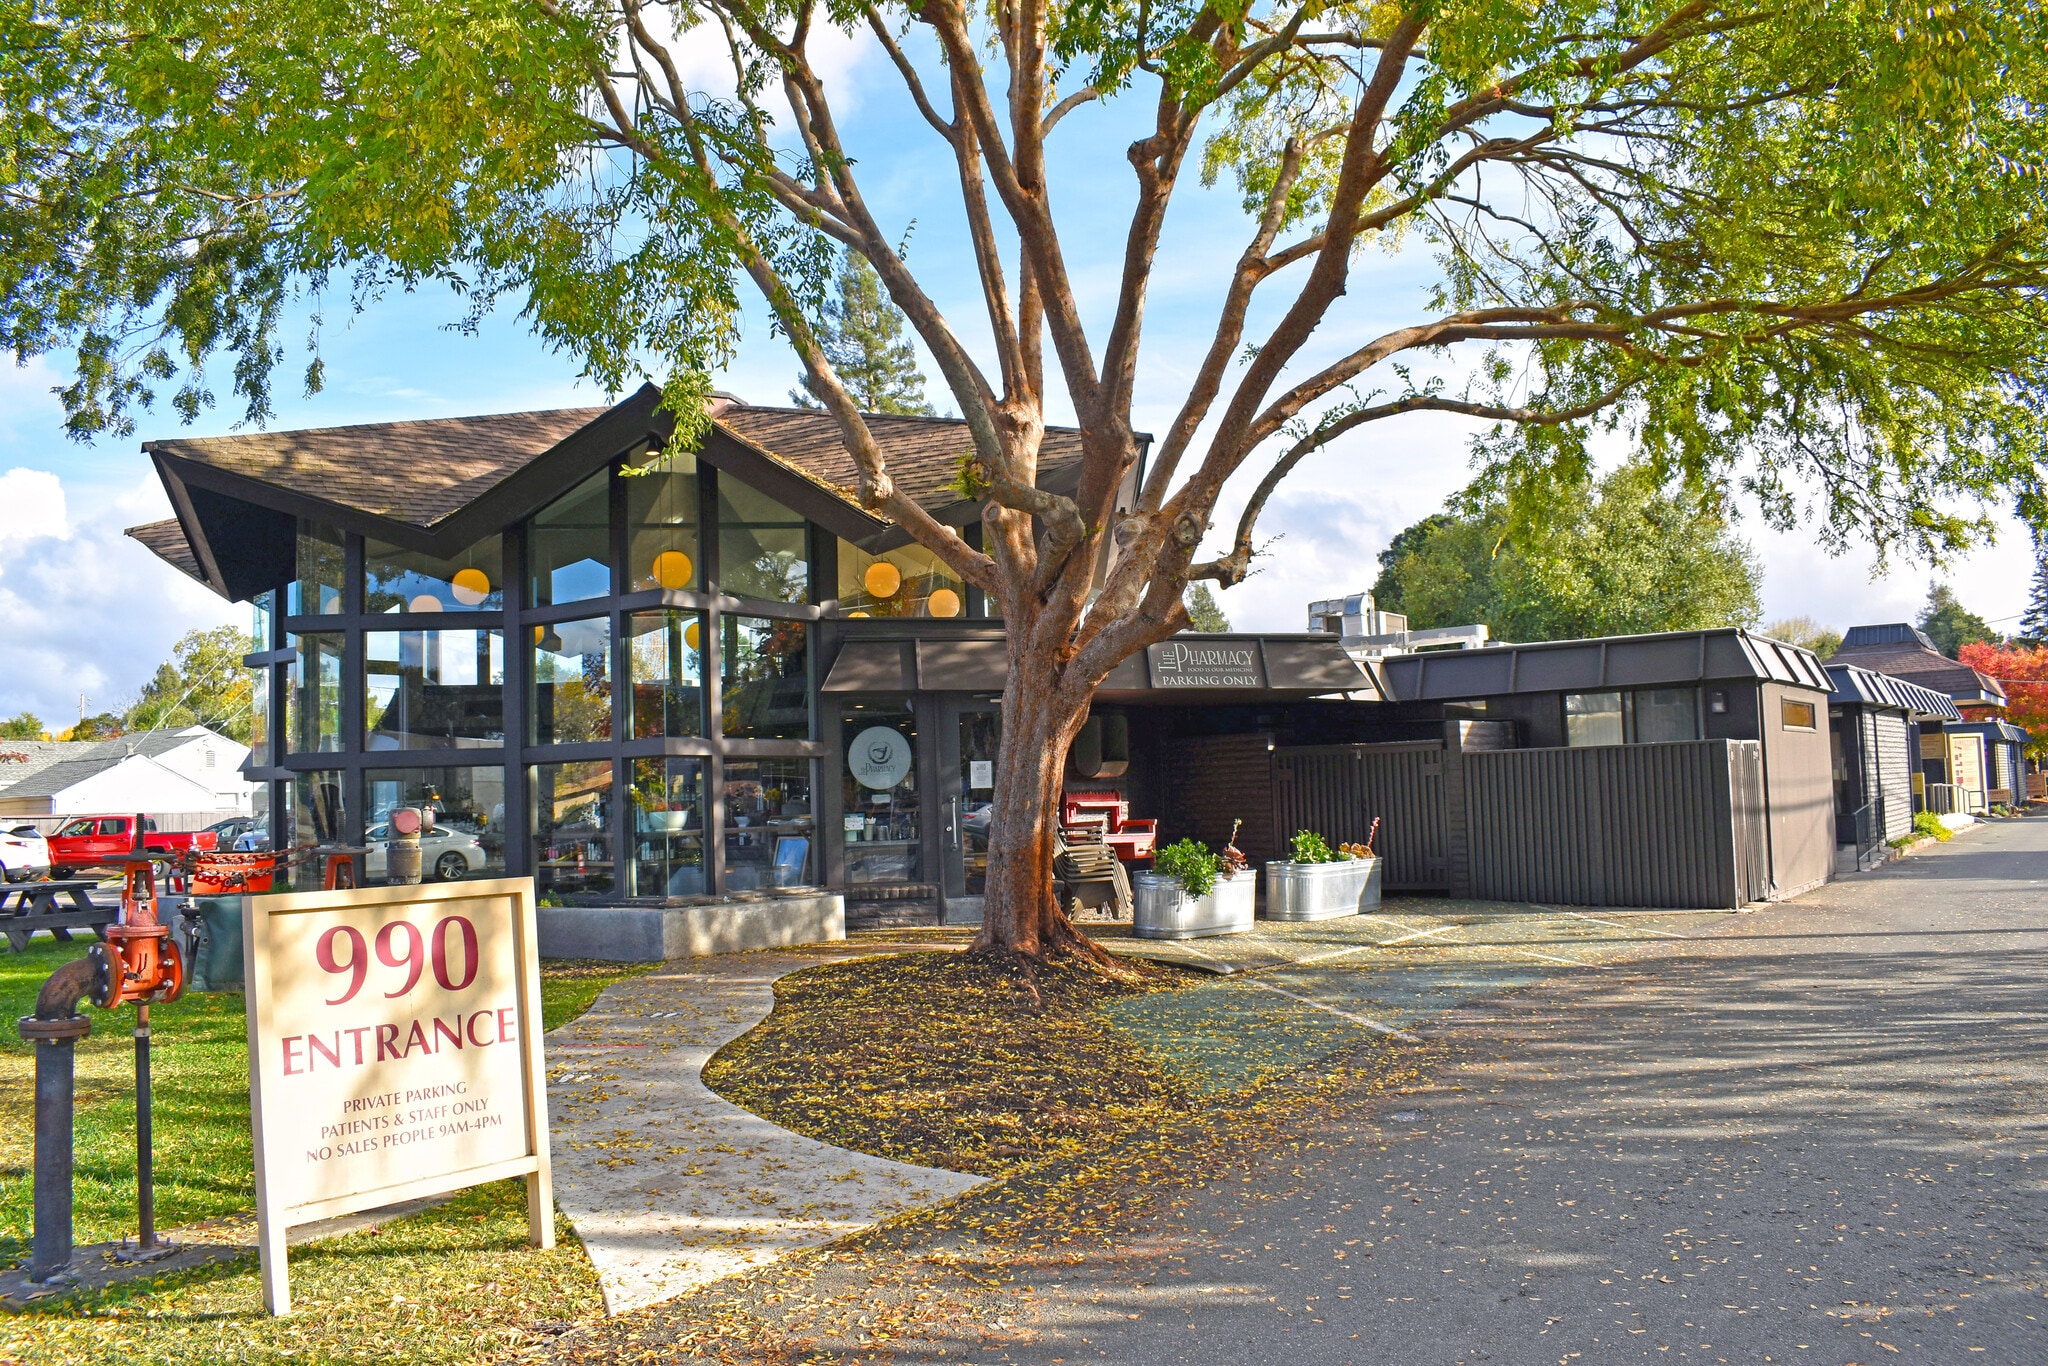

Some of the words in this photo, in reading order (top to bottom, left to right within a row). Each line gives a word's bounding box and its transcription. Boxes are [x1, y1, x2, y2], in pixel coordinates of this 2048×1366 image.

[1158, 650, 1177, 673] THE
[1174, 643, 1254, 673] PHARMACY
[1162, 675, 1220, 686] PARKING
[1223, 675, 1257, 686] ONLY
[315, 915, 479, 1006] 990
[281, 1007, 516, 1076] ENTRANCE
[343, 1091, 401, 1114] PRIVATE
[406, 1081, 467, 1103] PARKING
[321, 1115, 389, 1139] PATIENTS
[394, 1113, 404, 1126] &
[409, 1104, 448, 1124] STAFF
[452, 1098, 489, 1117] ONLY
[306, 1146, 332, 1163] NO
[337, 1138, 378, 1158] SALES
[383, 1126, 435, 1151] PEOPLE
[439, 1114, 502, 1138] 9AM-4PM
